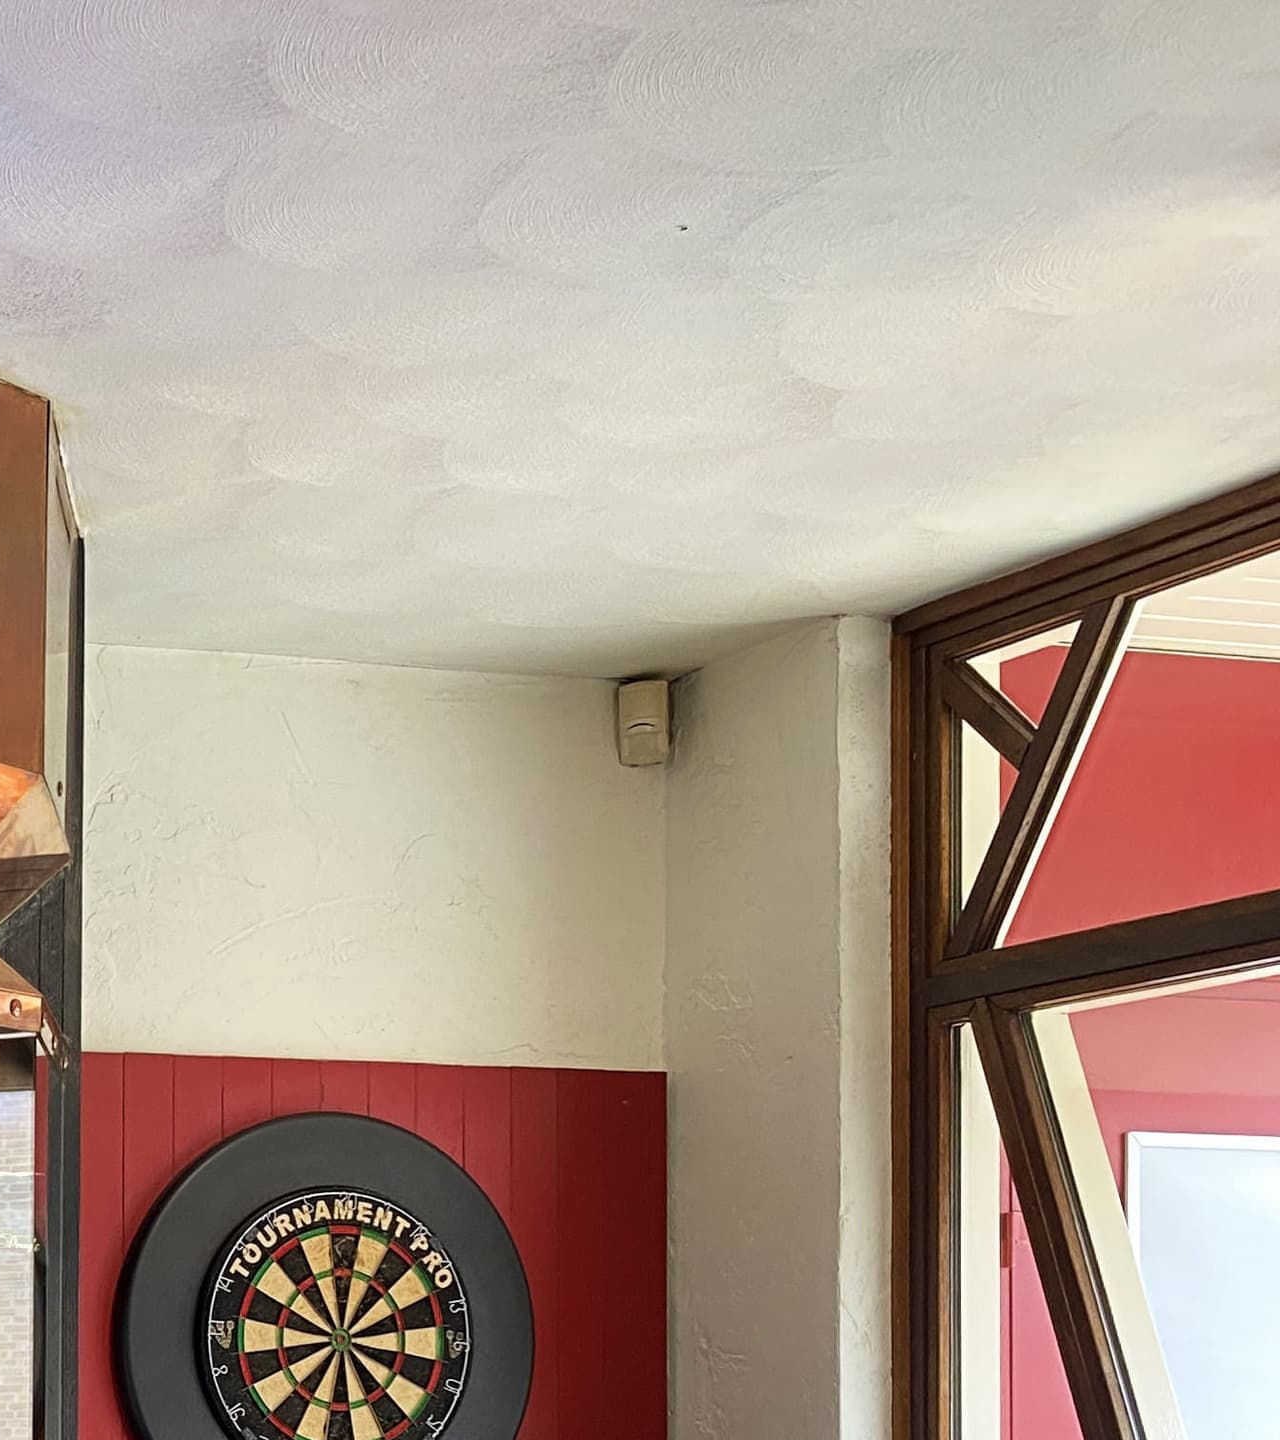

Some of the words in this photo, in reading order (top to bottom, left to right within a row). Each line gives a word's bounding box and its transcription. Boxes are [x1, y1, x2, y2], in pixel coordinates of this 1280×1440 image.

[229, 1199, 411, 1278] TOURNAMENT
[409, 1235, 453, 1289] PRO
[217, 1277, 234, 1293] 14
[213, 1364, 229, 1377] 8
[226, 1402, 246, 1423] 16
